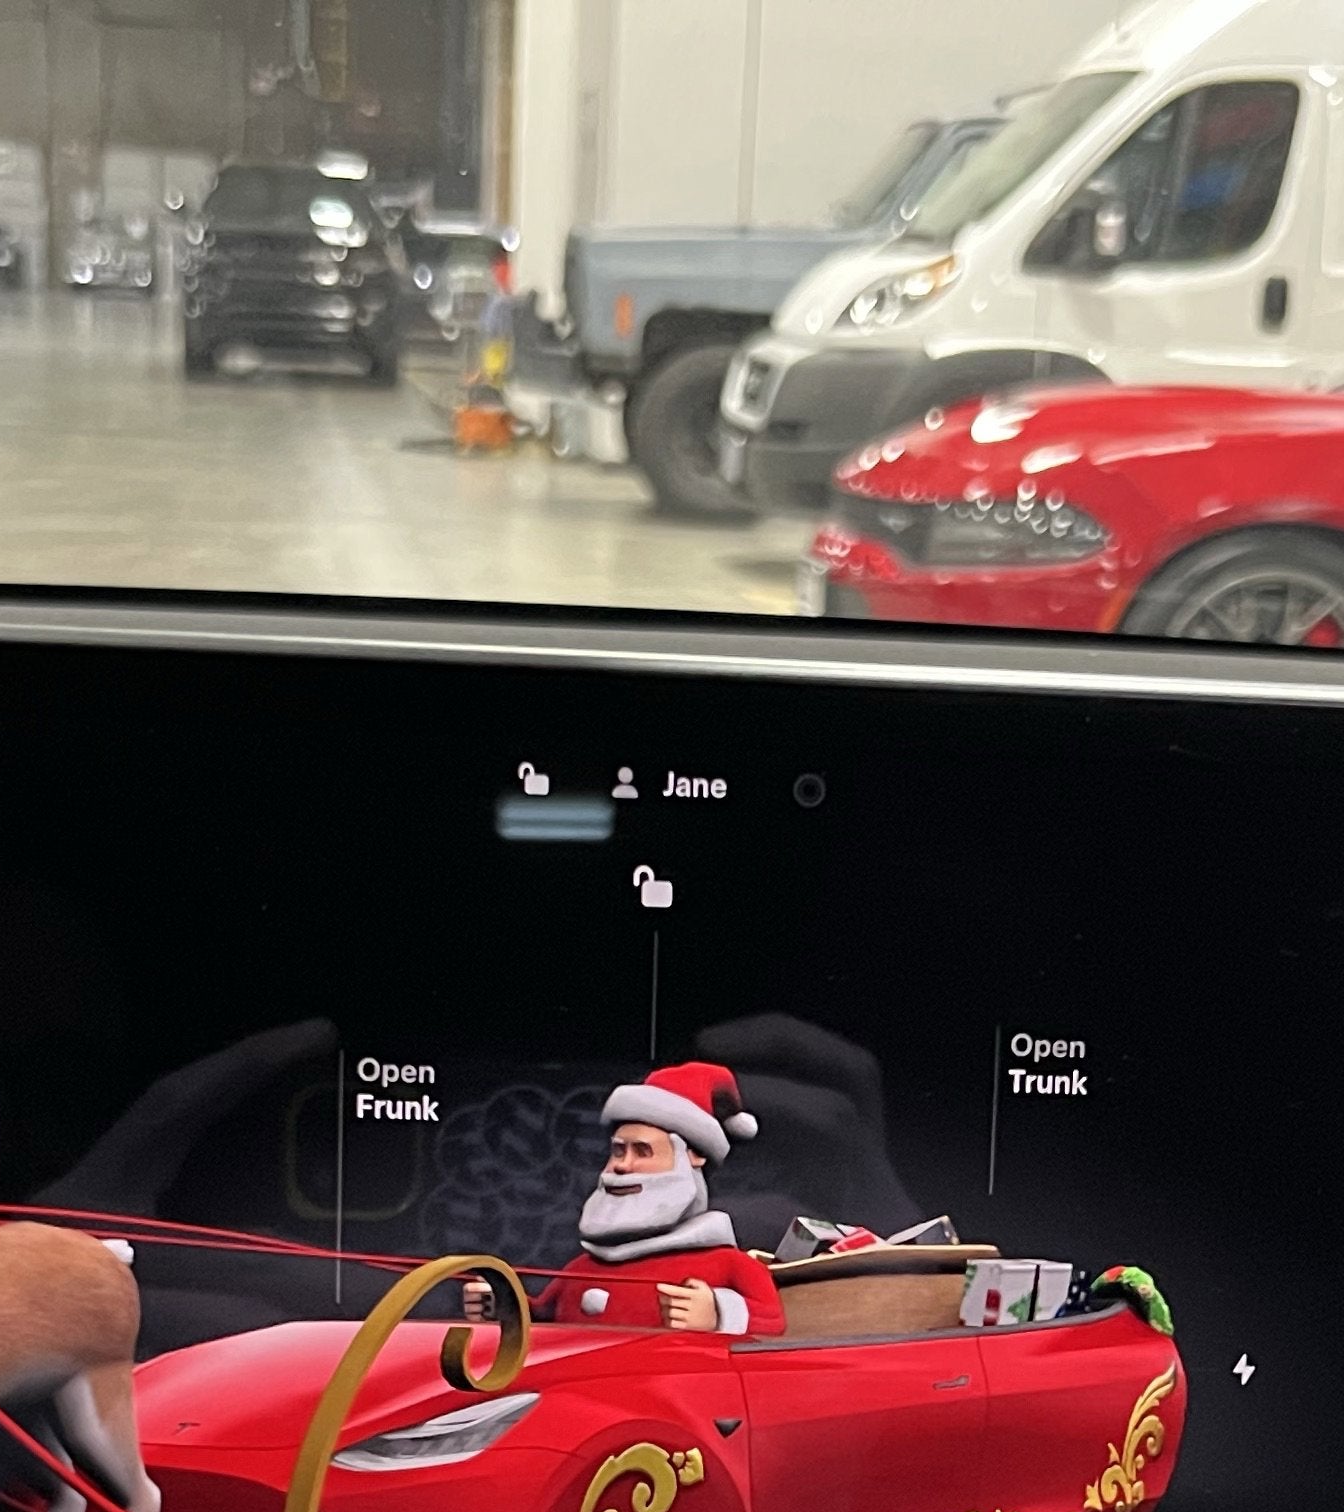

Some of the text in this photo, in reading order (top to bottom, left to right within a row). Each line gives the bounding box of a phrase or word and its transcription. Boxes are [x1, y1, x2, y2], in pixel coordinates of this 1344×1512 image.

[662, 770, 728, 799] Jane
[1010, 1032, 1086, 1063] Open
[357, 1057, 435, 1088] Open
[1007, 1068, 1088, 1096] Trunk
[356, 1093, 440, 1122] Frunk
